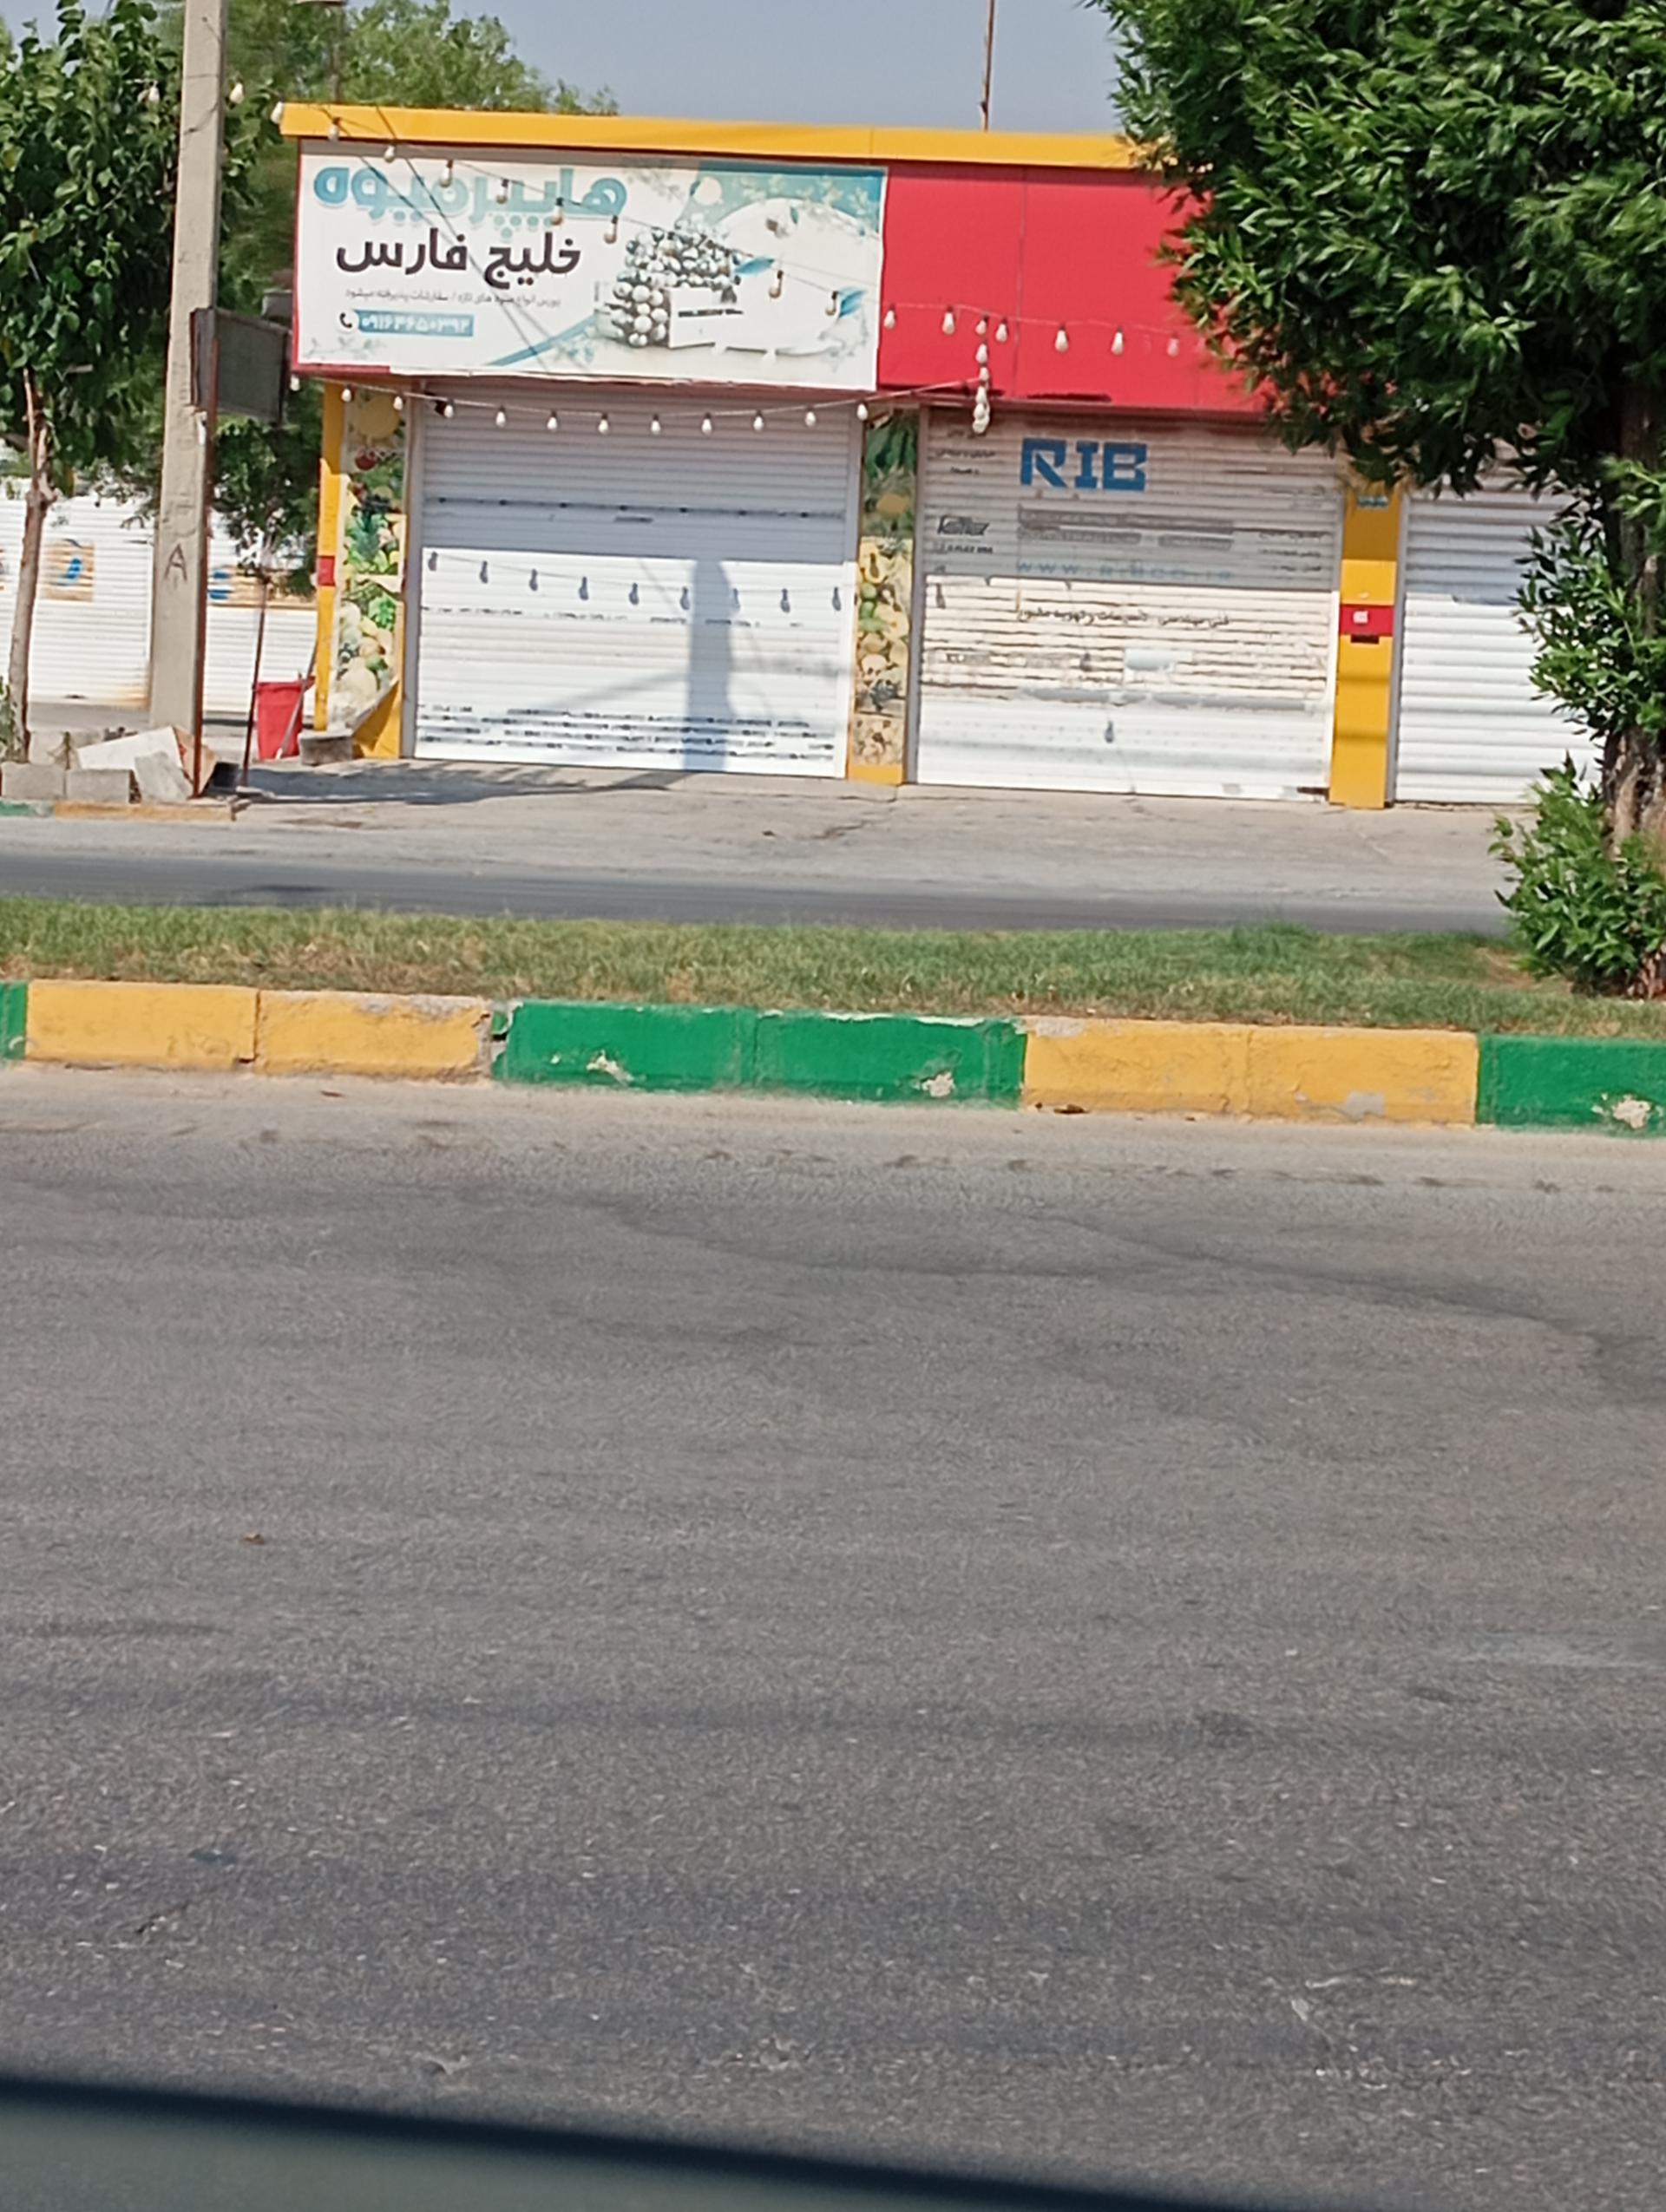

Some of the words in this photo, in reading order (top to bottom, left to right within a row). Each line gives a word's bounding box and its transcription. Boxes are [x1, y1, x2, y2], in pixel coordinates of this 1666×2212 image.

[336, 227, 468, 275] فارس
[483, 231, 581, 290] خلیج
[1020, 437, 1148, 492] RIB
